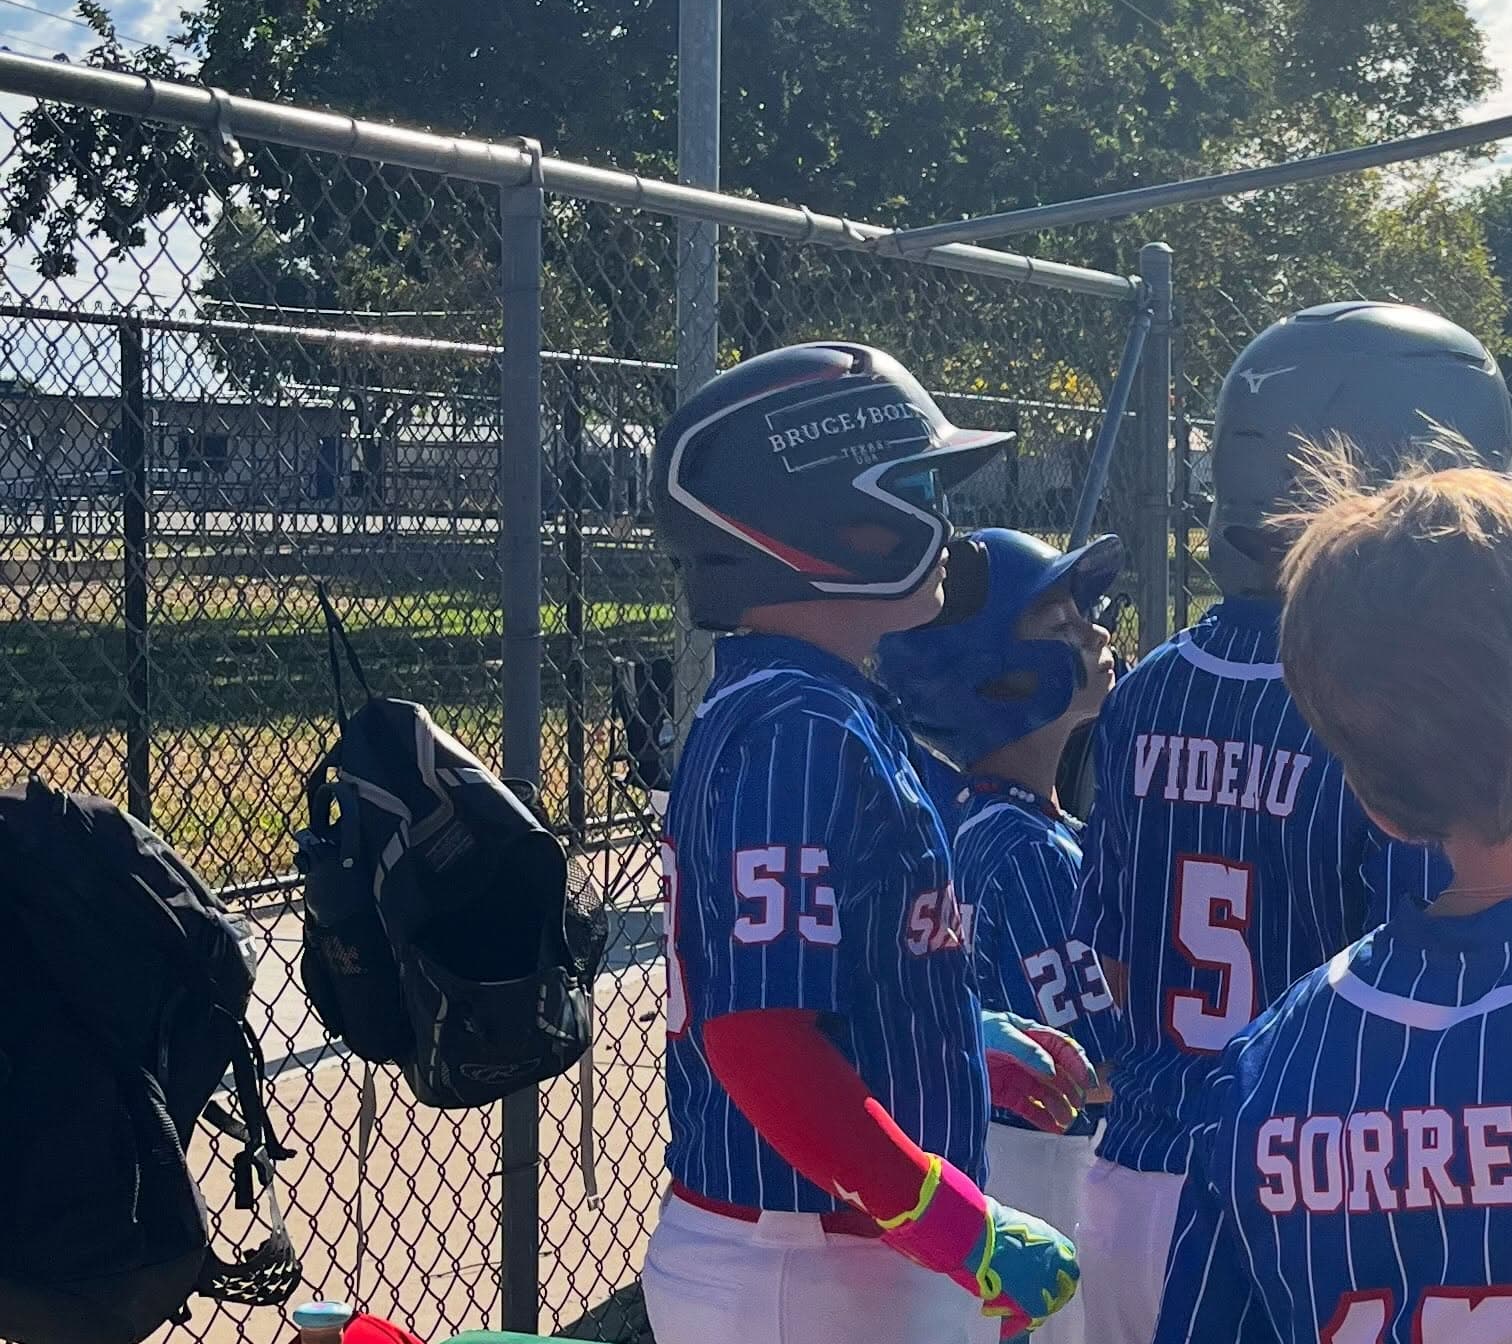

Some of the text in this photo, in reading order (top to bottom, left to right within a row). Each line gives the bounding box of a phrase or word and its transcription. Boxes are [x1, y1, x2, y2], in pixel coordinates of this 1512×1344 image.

[768, 417, 855, 452] BRUCE
[1133, 732, 1312, 818] VIDEAU
[1023, 939, 1117, 1029] 23
[1166, 854, 1257, 1053] 5
